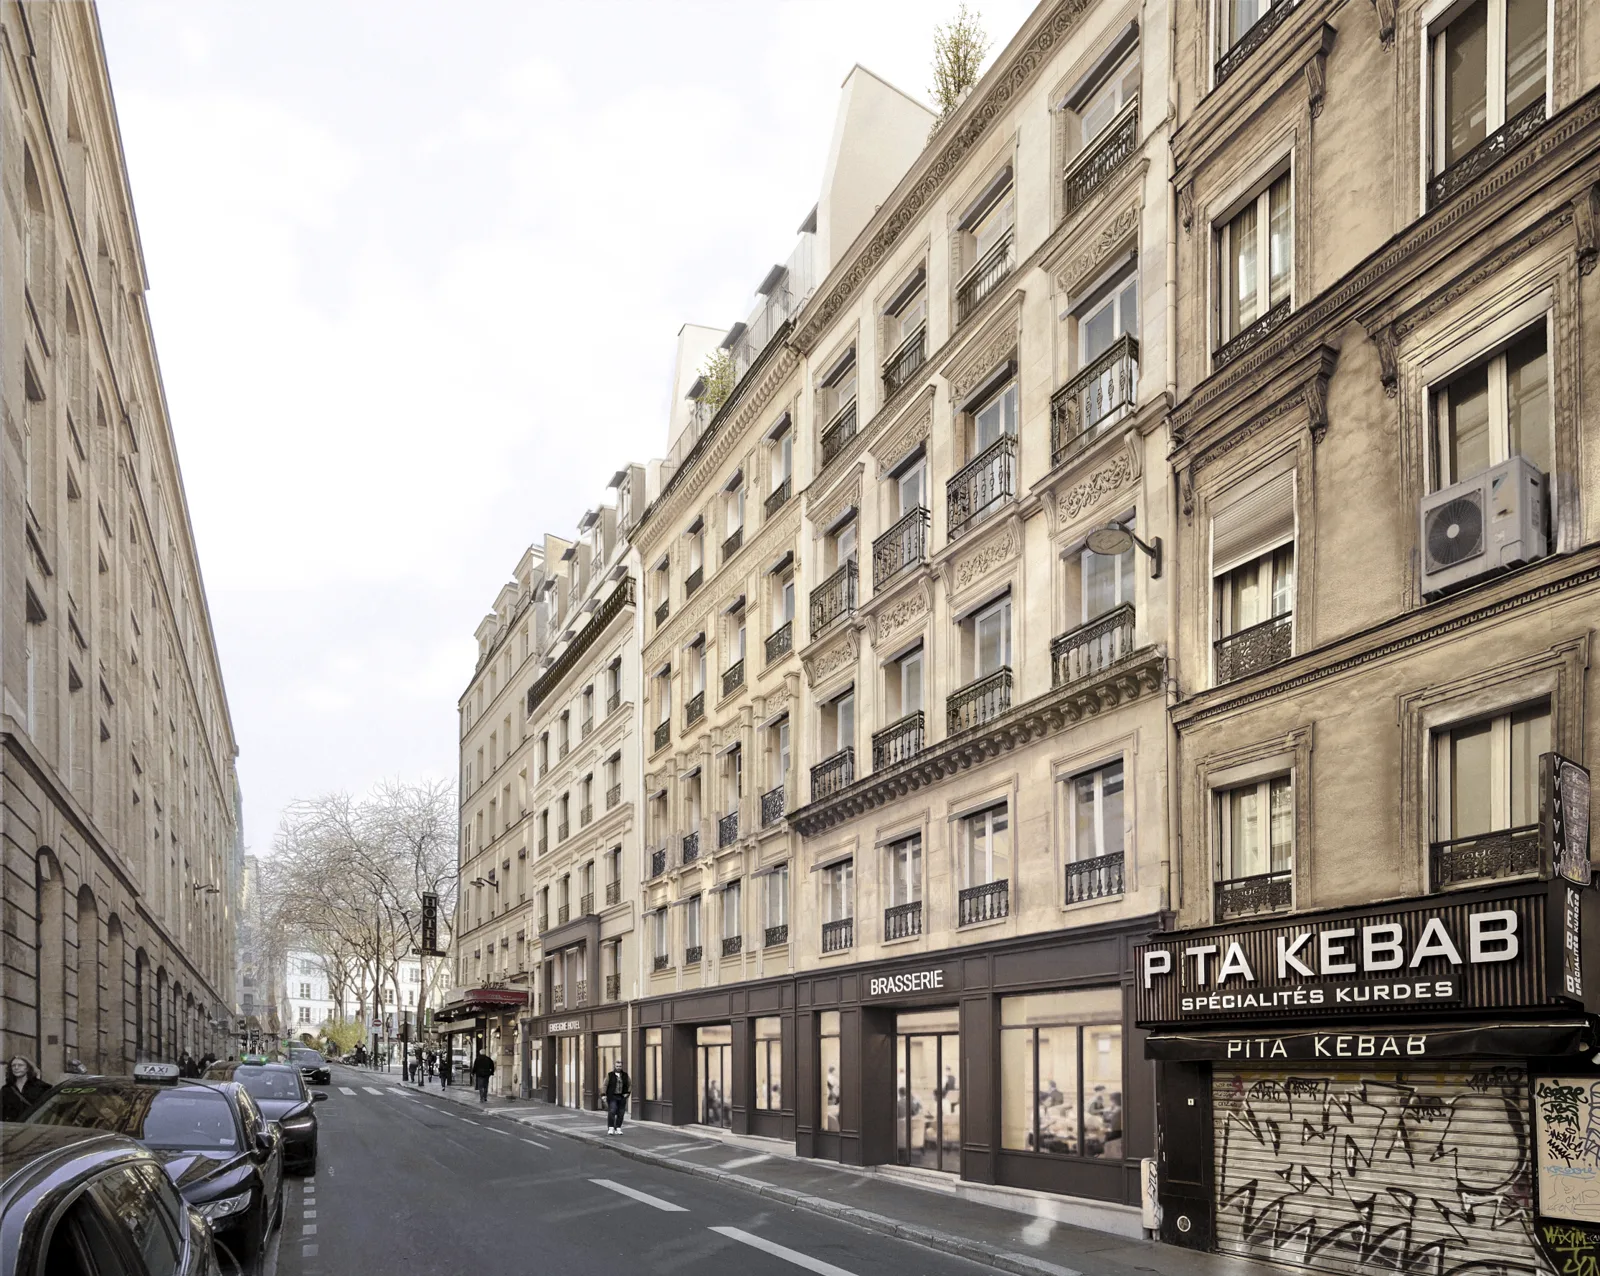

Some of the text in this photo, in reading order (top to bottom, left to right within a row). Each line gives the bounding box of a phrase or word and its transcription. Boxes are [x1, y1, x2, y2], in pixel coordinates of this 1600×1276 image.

[1144, 909, 1519, 989] PTA KEBAB
[870, 969, 944, 996] BRASSERIE
[1181, 981, 1453, 1011] SPÉCIALITÉS KURDES
[1227, 1034, 1427, 1058] PITA KEBAB
